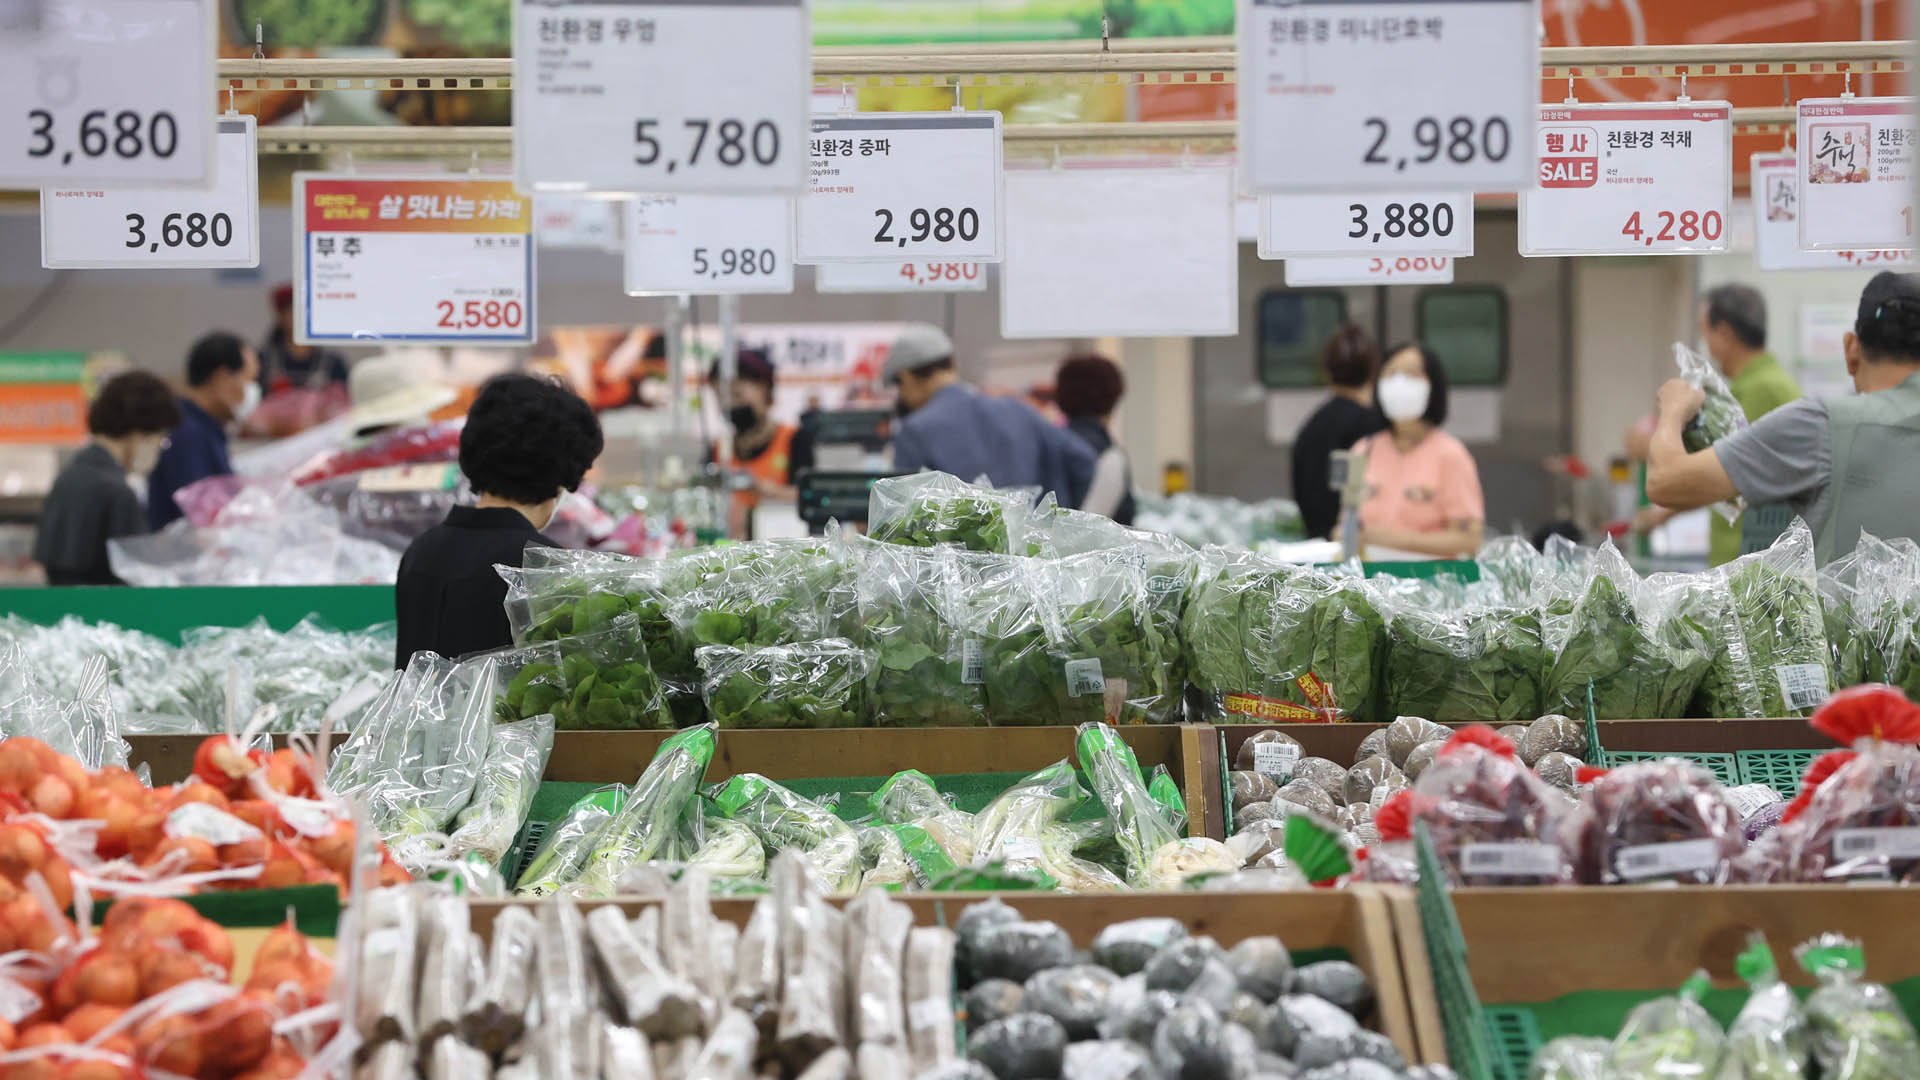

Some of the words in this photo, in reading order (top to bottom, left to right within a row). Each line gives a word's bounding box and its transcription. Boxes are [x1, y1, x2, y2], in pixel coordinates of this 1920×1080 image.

[539, 19, 603, 43] 친환경
[1269, 17, 1330, 42] 친환경
[1338, 17, 1443, 41] 미니단호박
[27, 110, 179, 166] 3,680
[634, 118, 781, 173] 5,780
[809, 138, 853, 157] 친환경
[859, 138, 891, 156] 중파
[1362, 117, 1511, 172] 2,980
[1606, 130, 1654, 149] 친환경
[1660, 130, 1692, 149] 적채
[1816, 130, 1856, 174] 추석
[1540, 162, 1594, 182] SALE
[379, 194, 404, 219] 살
[407, 194, 475, 219] 맛나는
[125, 212, 233, 253] 3,680
[874, 207, 980, 248] 2,980
[1348, 202, 1454, 243] 3,880
[1621, 210, 1723, 246] 4,280
[693, 248, 776, 279] 5,980
[900, 263, 978, 287] 4,980
[437, 301, 522, 330] 2,580
